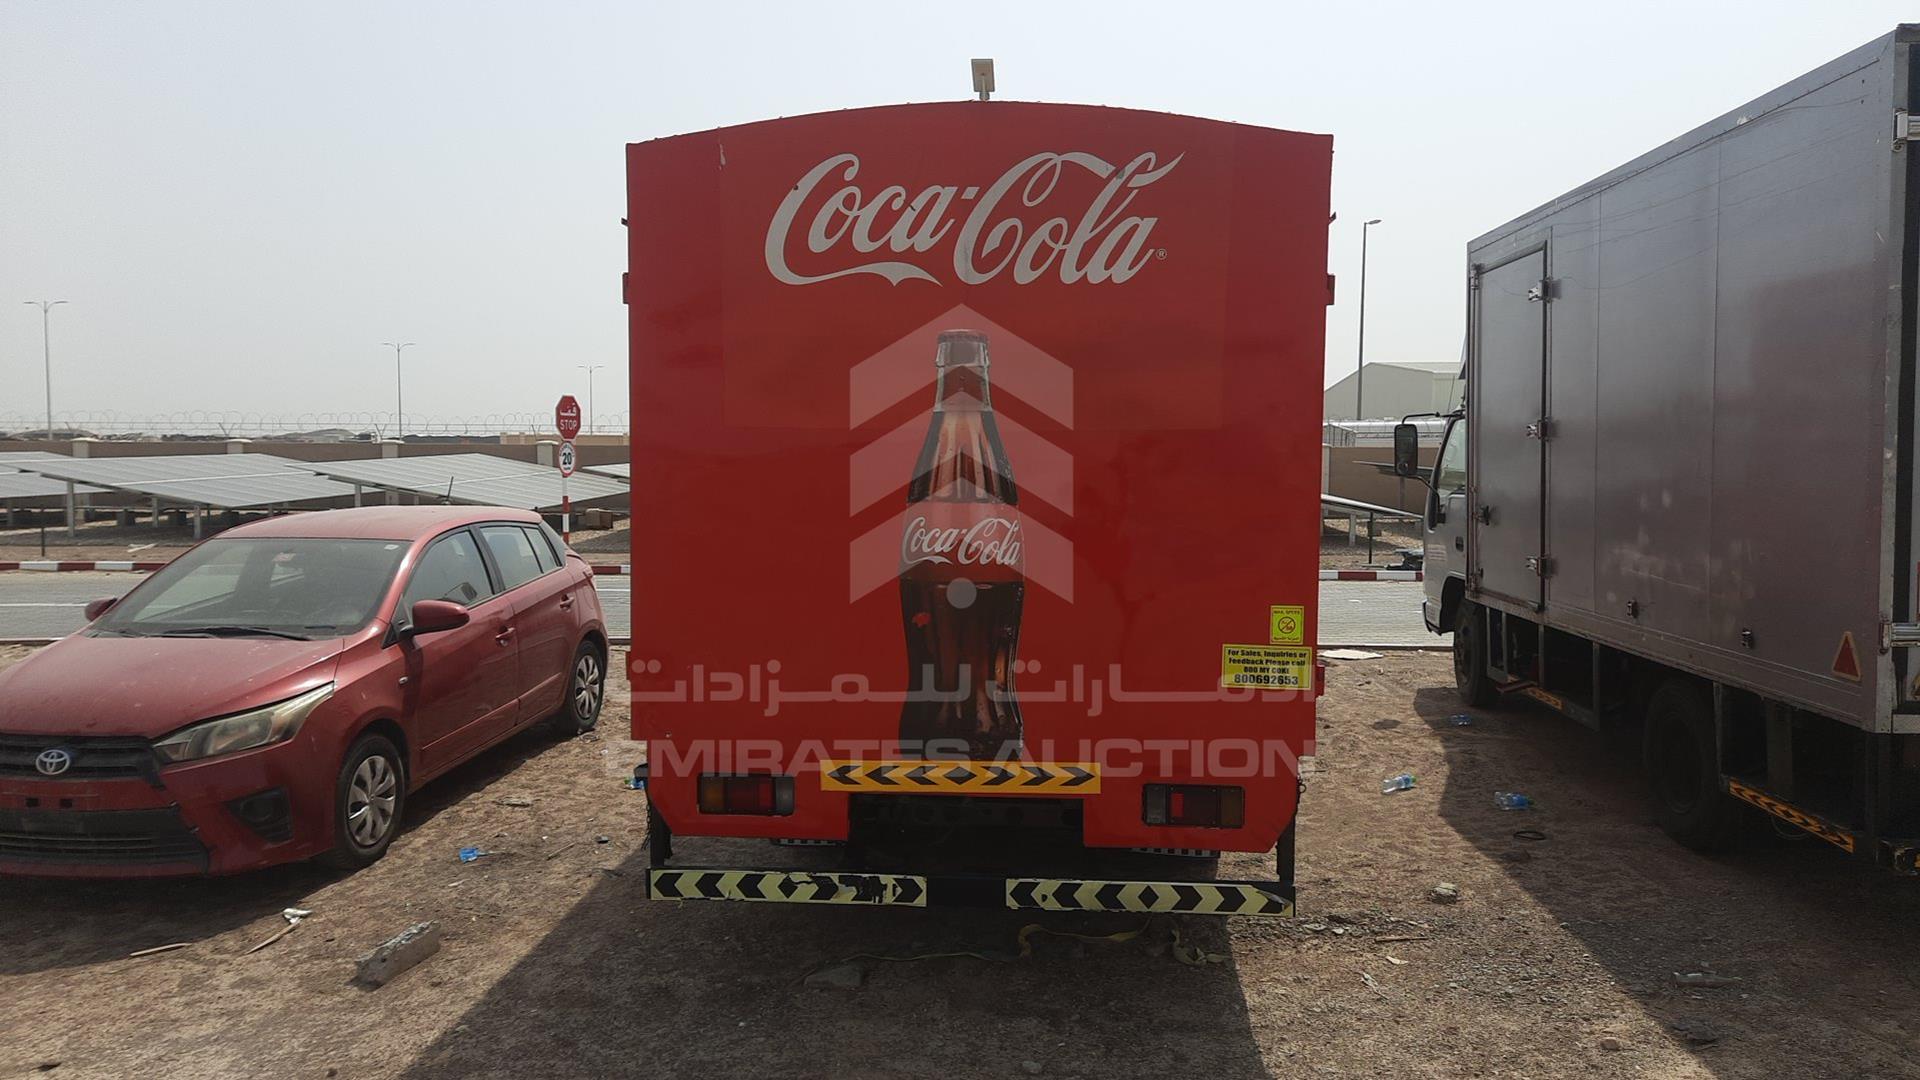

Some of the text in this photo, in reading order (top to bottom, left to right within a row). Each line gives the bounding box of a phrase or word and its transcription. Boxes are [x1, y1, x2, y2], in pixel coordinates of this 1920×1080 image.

[764, 151, 1185, 287] Coca-Cola
[560, 419, 577, 430] STOP
[562, 452, 573, 465] 20
[902, 516, 1021, 565] Coca-Cola
[1264, 650, 1297, 658] Inquiries
[1228, 657, 1264, 665] Feedback
[1265, 658, 1290, 666] Please
[1234, 673, 1298, 685] 800692653
